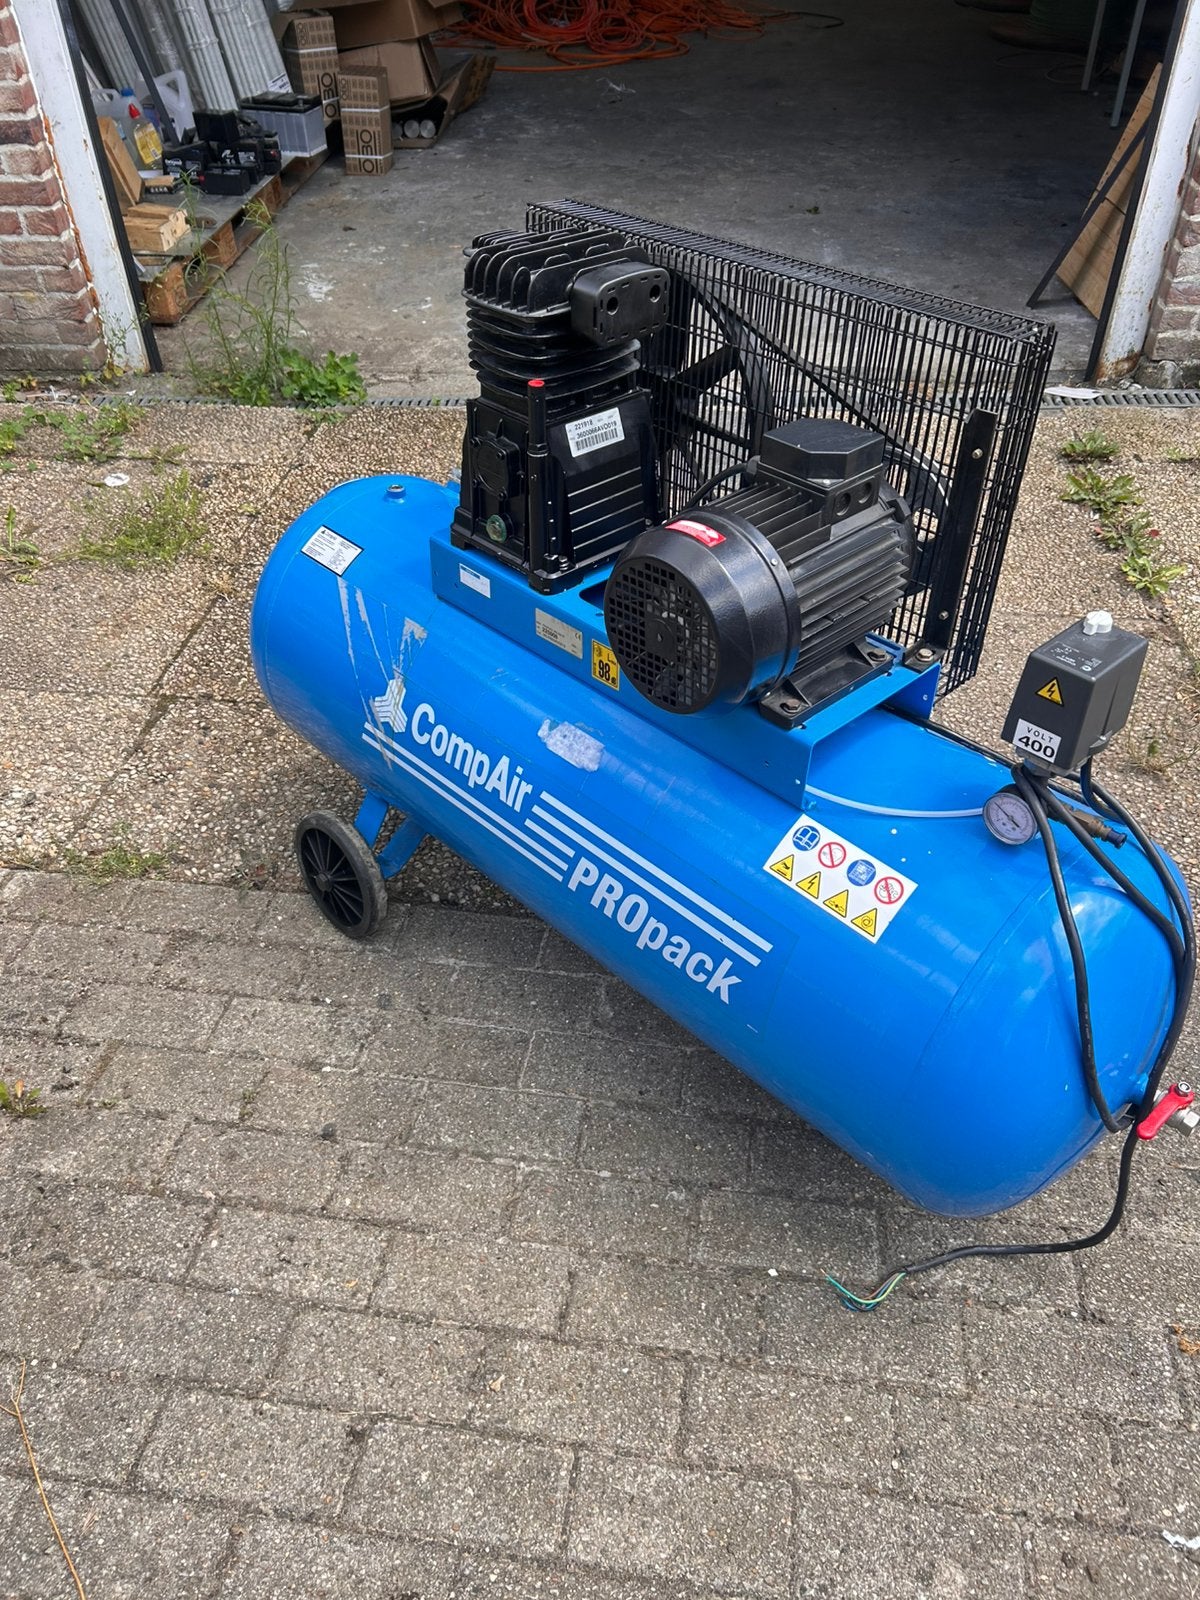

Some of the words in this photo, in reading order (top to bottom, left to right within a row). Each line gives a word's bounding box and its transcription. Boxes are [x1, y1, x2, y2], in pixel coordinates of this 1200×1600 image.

[320, 72, 337, 118] OBO
[360, 129, 375, 173] OBO
[598, 658, 611, 681] 98
[1018, 735, 1056, 758] 400
[1027, 726, 1054, 743] VOLT
[411, 703, 533, 813] CompAir
[567, 857, 742, 1005] PROpack
